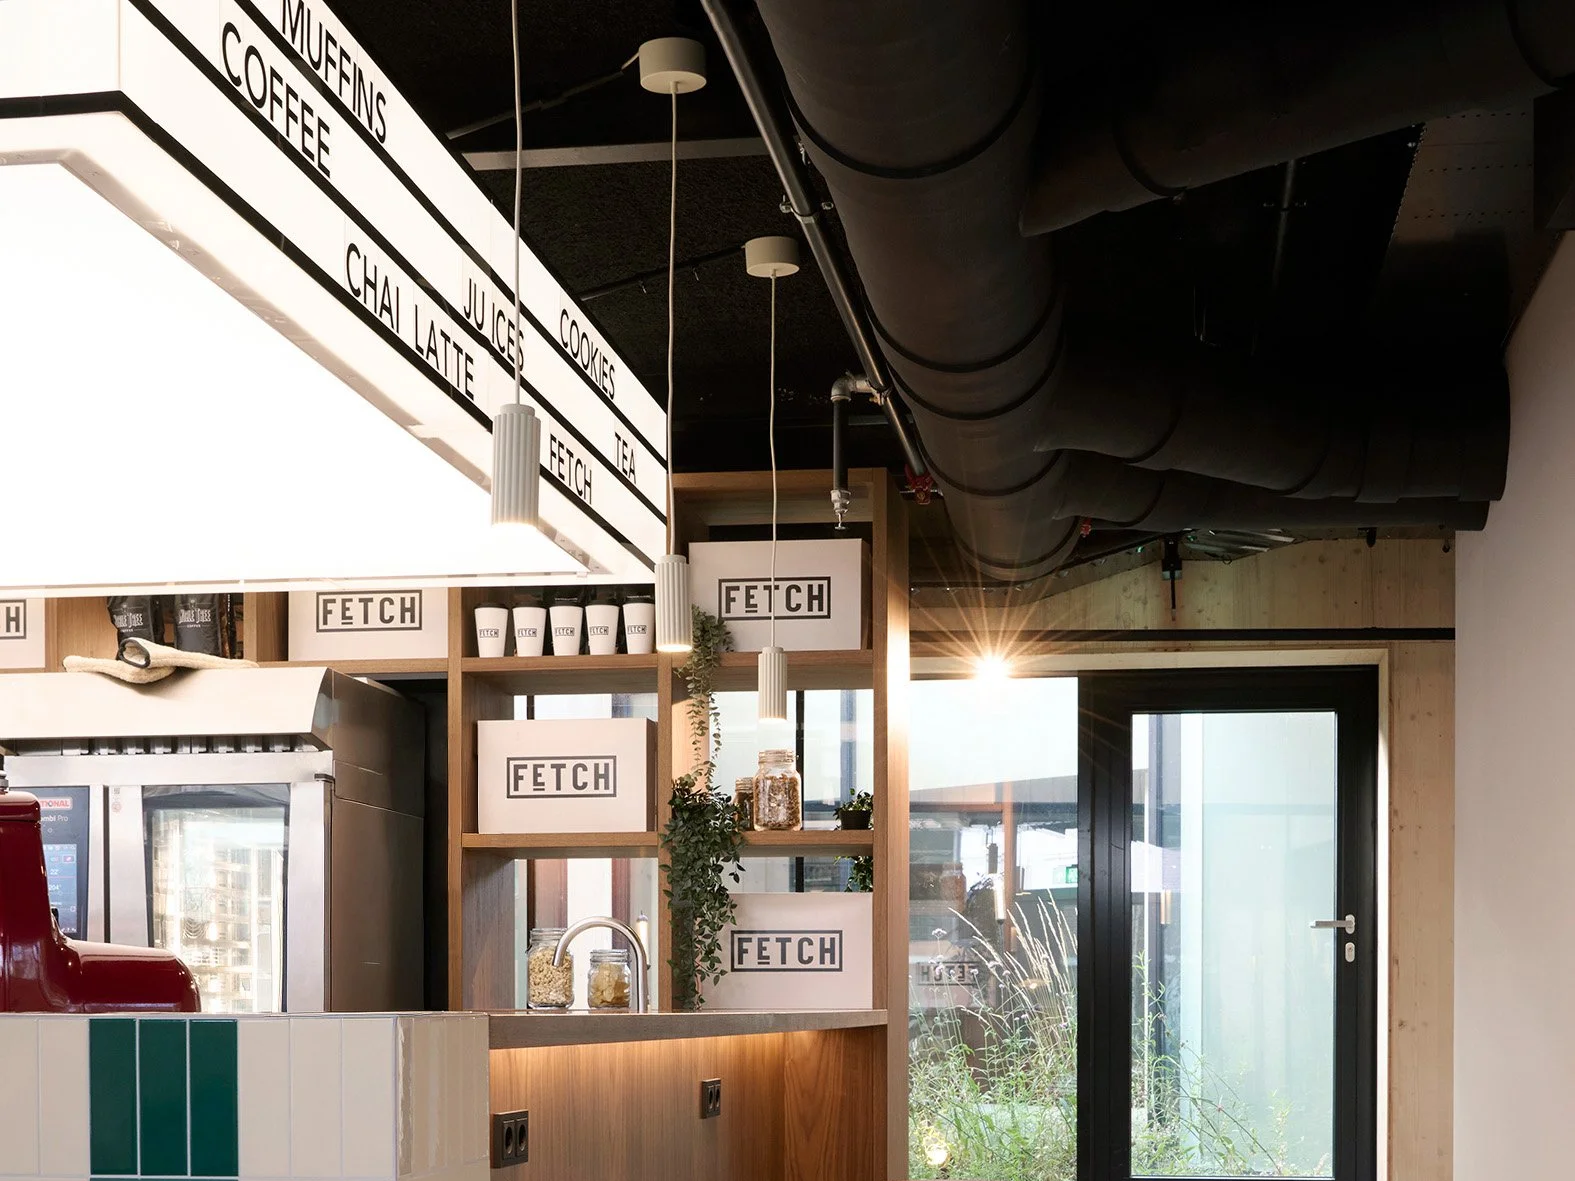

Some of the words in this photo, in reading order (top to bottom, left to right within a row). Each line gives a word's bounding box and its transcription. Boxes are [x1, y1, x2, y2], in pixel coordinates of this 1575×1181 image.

[281, 0, 387, 144] MUFFINS
[222, 21, 331, 179] COFFEE
[346, 243, 400, 334] CHAI
[415, 304, 474, 401] LATTE
[560, 308, 616, 400] COOKIES
[550, 433, 592, 505] FETCH
[614, 431, 637, 485] TEA
[322, 596, 416, 626] FETCH
[725, 584, 824, 614] FETCH
[40, 800, 70, 808] TIONAL
[513, 762, 610, 792] FETCH
[737, 936, 836, 966] FETCH
